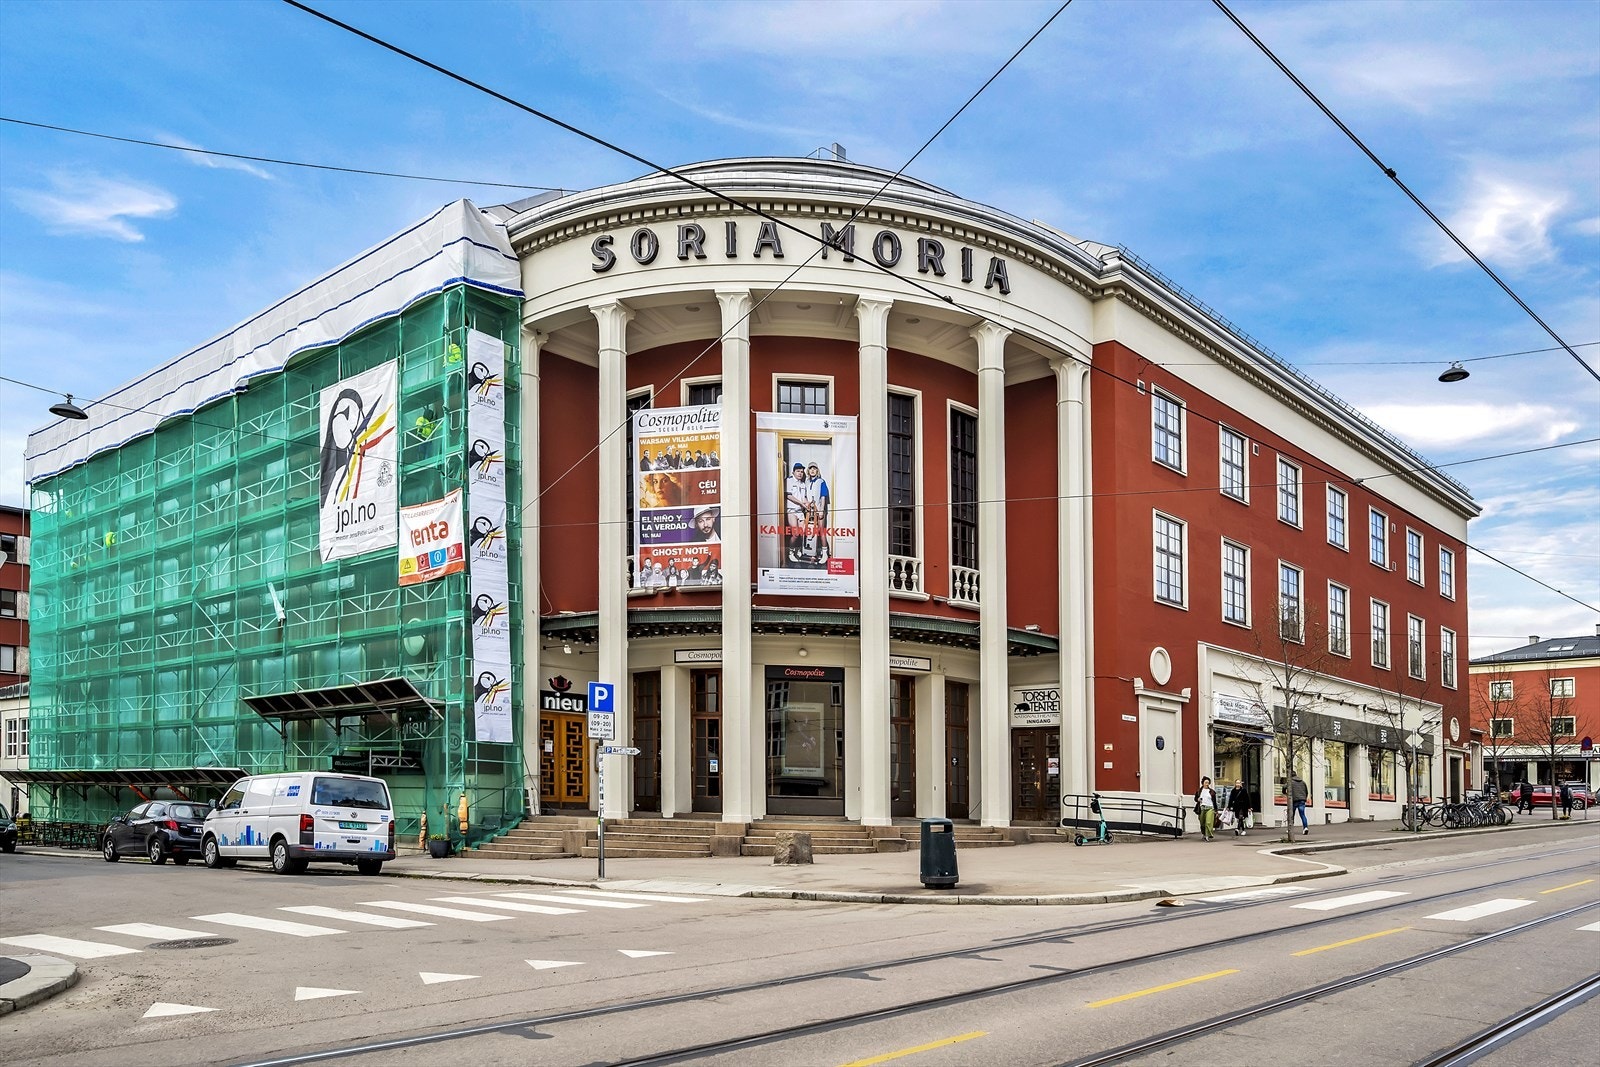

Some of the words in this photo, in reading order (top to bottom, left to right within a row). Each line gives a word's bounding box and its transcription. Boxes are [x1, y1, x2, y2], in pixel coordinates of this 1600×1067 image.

[591, 221, 784, 273] SORIA
[820, 222, 1011, 295] MORIA
[478, 394, 496, 406] jpl.no
[638, 407, 720, 431] Cosmopolite
[640, 437, 671, 445] WARSAW
[672, 435, 699, 443] VILLAGE
[478, 471, 497, 483] jpl.no
[698, 480, 717, 490] CÉU
[335, 502, 377, 533] jpl.no
[654, 514, 674, 523] NIÑO
[642, 523, 652, 531] LA
[655, 522, 687, 531] VERDAD
[410, 520, 449, 548] renta
[480, 549, 498, 559] jpl.no
[652, 548, 683, 557] GHOST
[685, 546, 709, 555] NOTE
[481, 626, 501, 636] jpl.no
[688, 651, 722, 661] Cosmopol
[889, 658, 918, 667] mopolite
[784, 668, 825, 678] Cosmopolite
[544, 692, 583, 712] nieu
[594, 686, 609, 708] P
[484, 703, 503, 712] jpl.no
[1029, 701, 1060, 712] TEATRET
